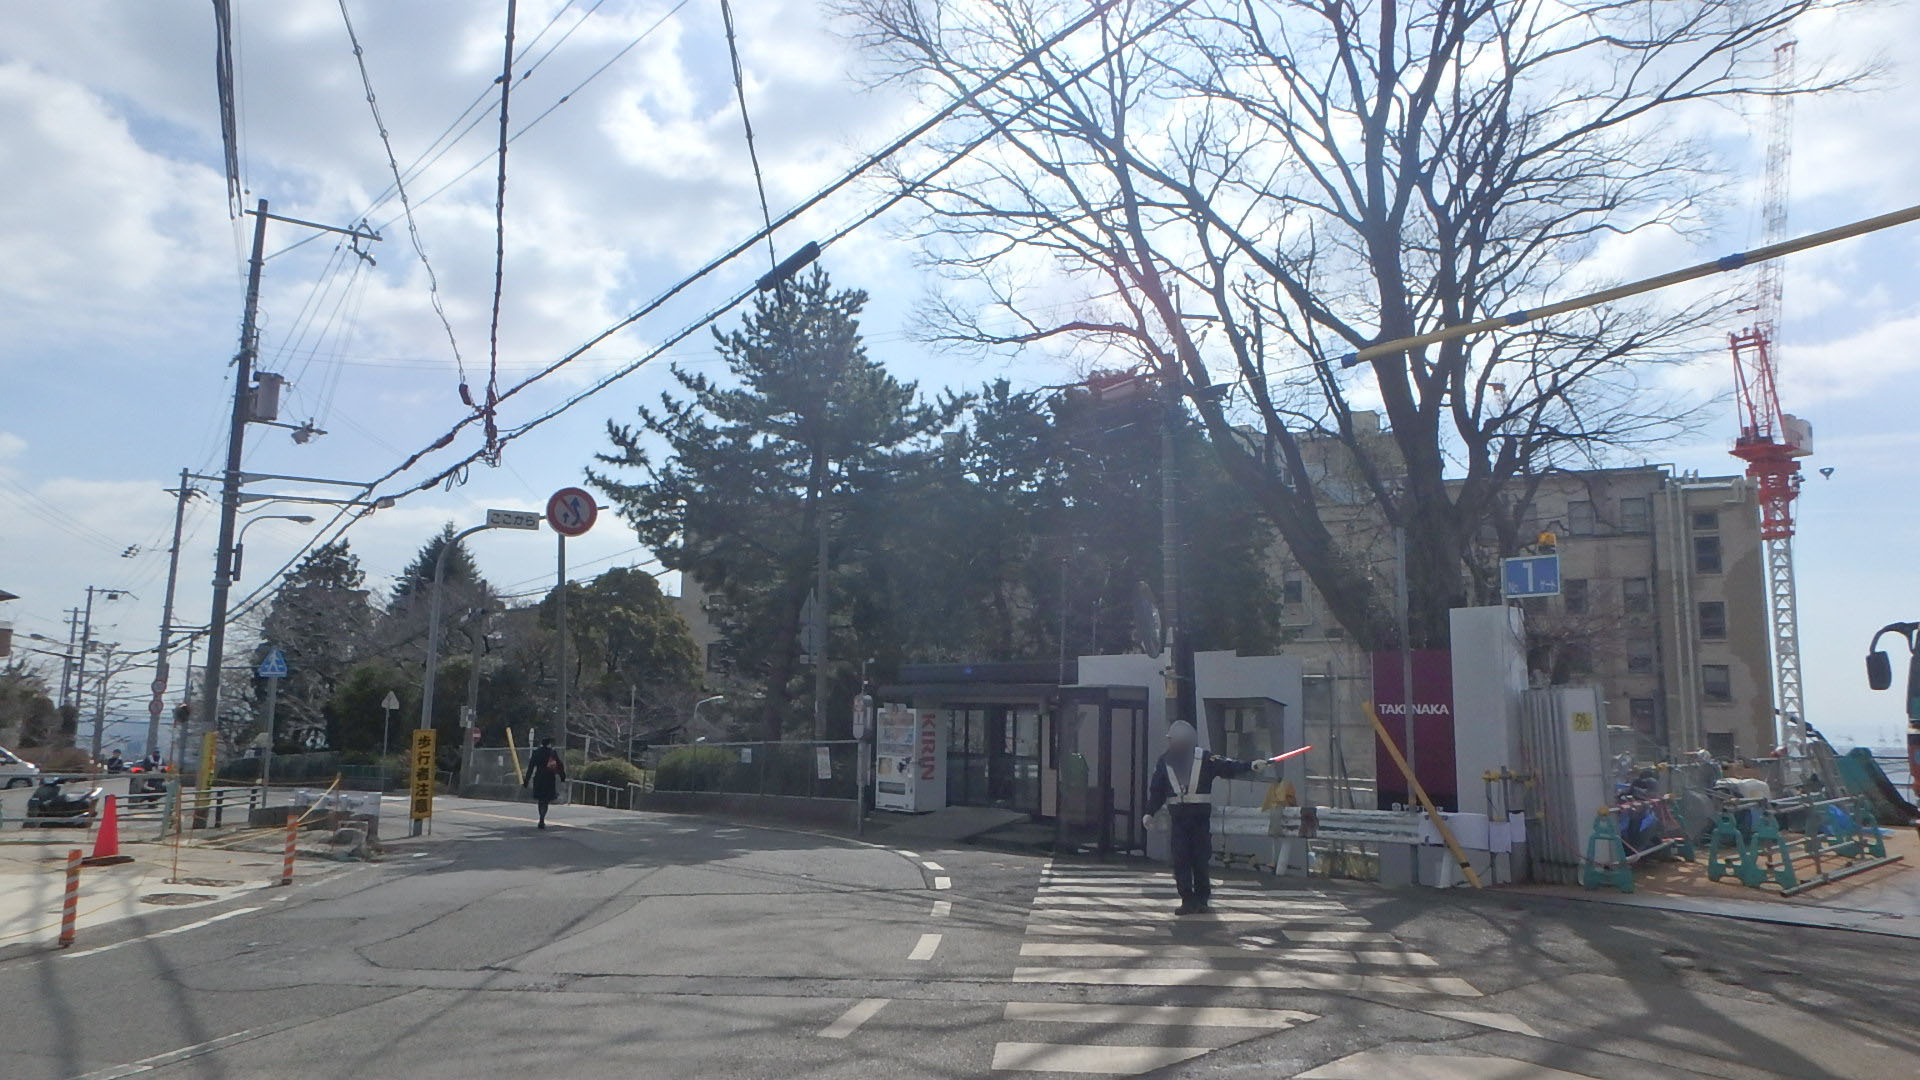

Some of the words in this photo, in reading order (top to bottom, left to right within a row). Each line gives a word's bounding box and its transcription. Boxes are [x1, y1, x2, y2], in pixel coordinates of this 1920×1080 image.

[490, 512, 536, 527] ここから
[1522, 561, 1534, 592] 1
[921, 711, 936, 780] KIRIN
[415, 735, 431, 813] 歩行者注意
